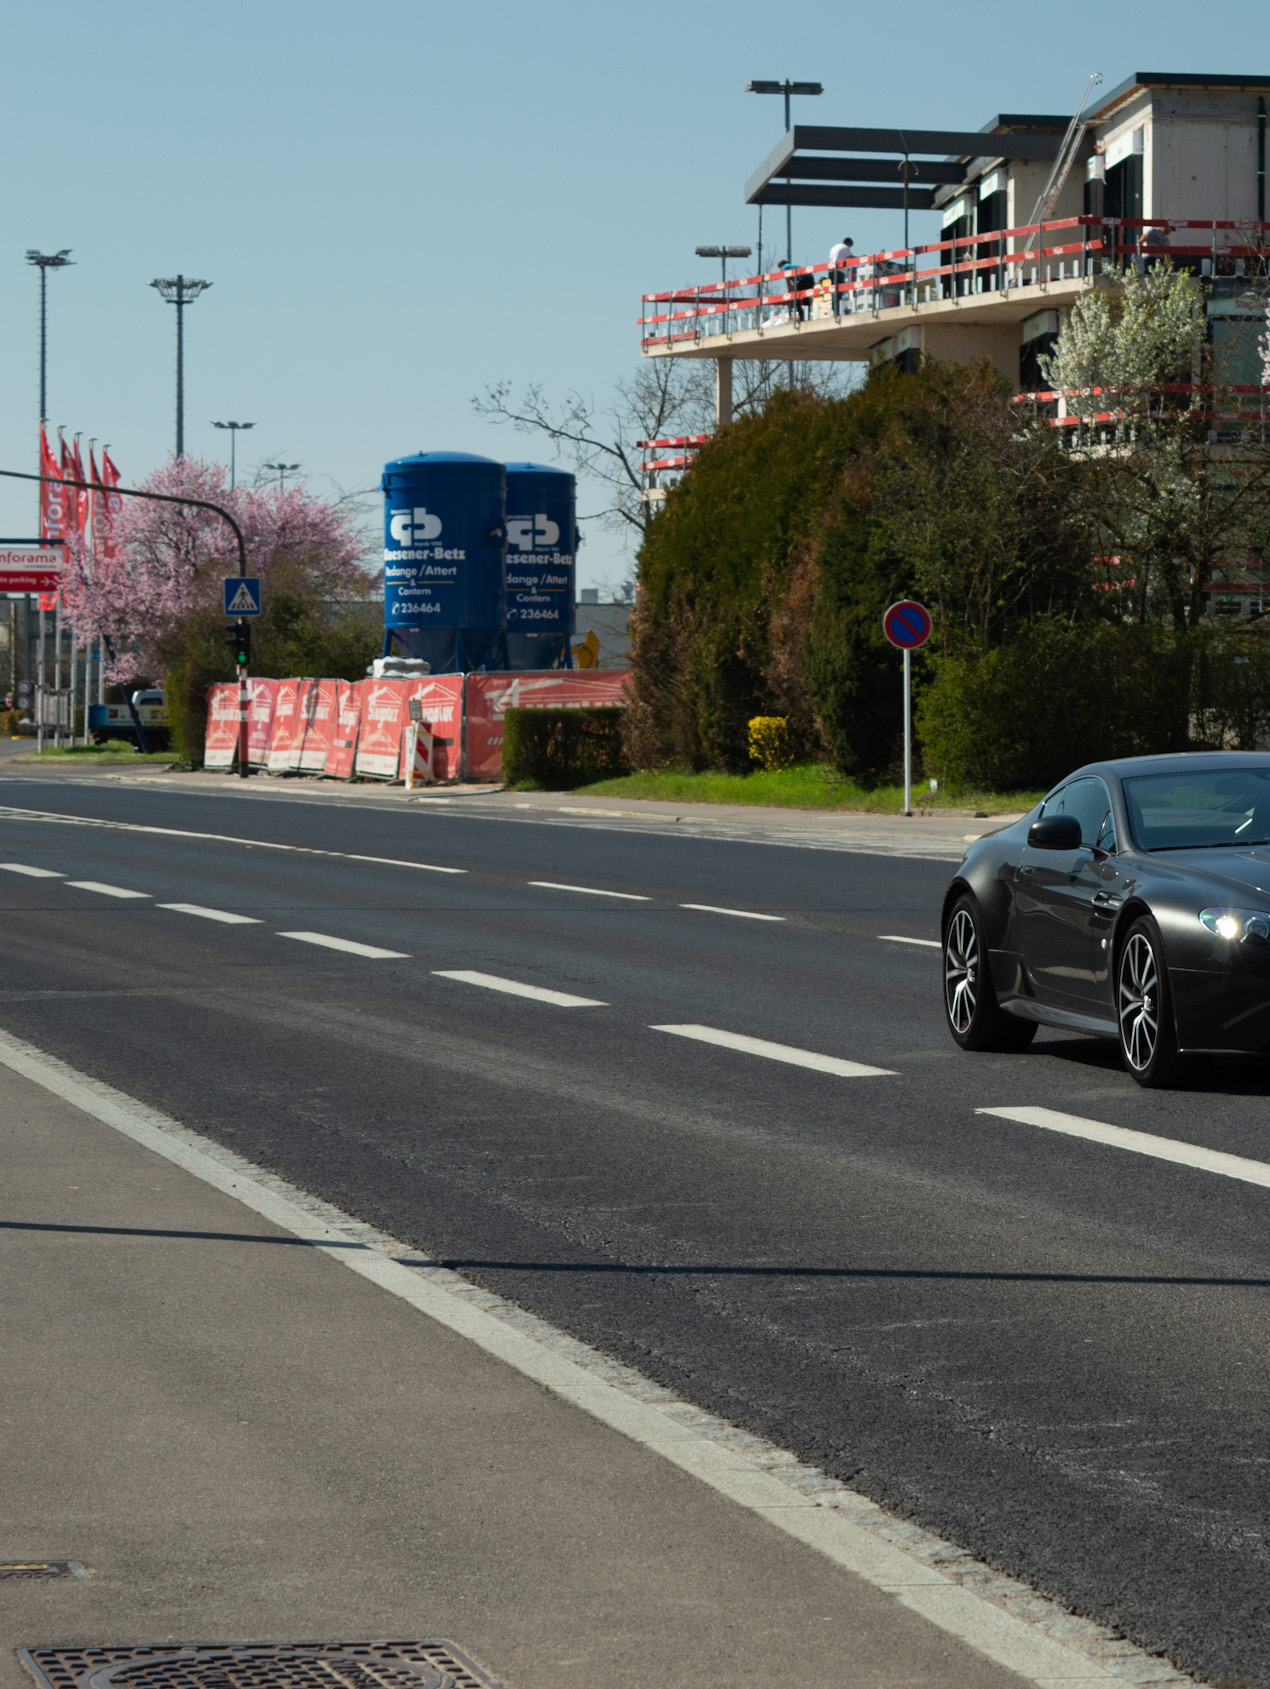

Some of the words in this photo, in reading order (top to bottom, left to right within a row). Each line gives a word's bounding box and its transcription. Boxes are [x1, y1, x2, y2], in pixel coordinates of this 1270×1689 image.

[398, 587, 431, 596] Contern
[516, 594, 551, 603] Contern
[401, 602, 441, 613] 236464
[520, 609, 560, 620] 236464
